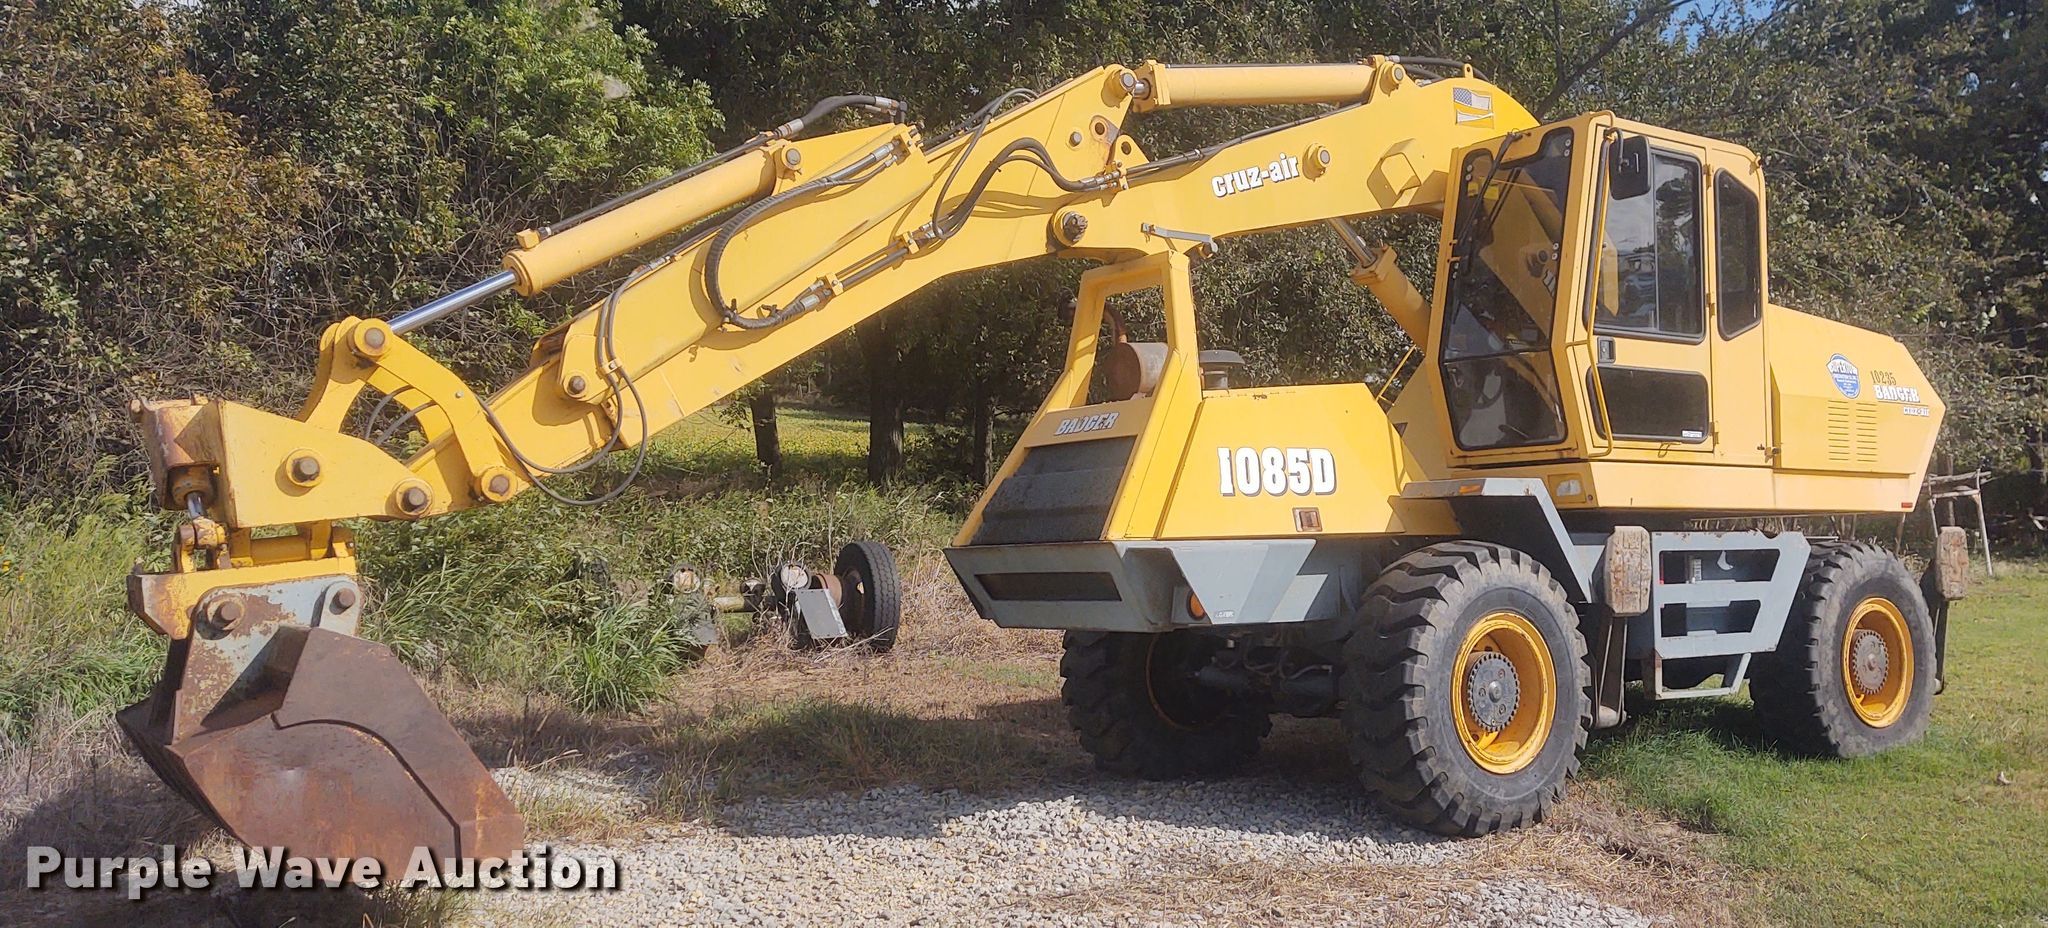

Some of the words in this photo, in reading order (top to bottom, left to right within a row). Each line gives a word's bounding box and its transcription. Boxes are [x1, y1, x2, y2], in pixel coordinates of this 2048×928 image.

[1212, 152, 1300, 198] cruz-air
[1870, 370, 1897, 386] 10235
[1873, 385, 1920, 403] BADGER
[1054, 412, 1119, 436] BADGER
[1217, 446, 1337, 497] 1085D
